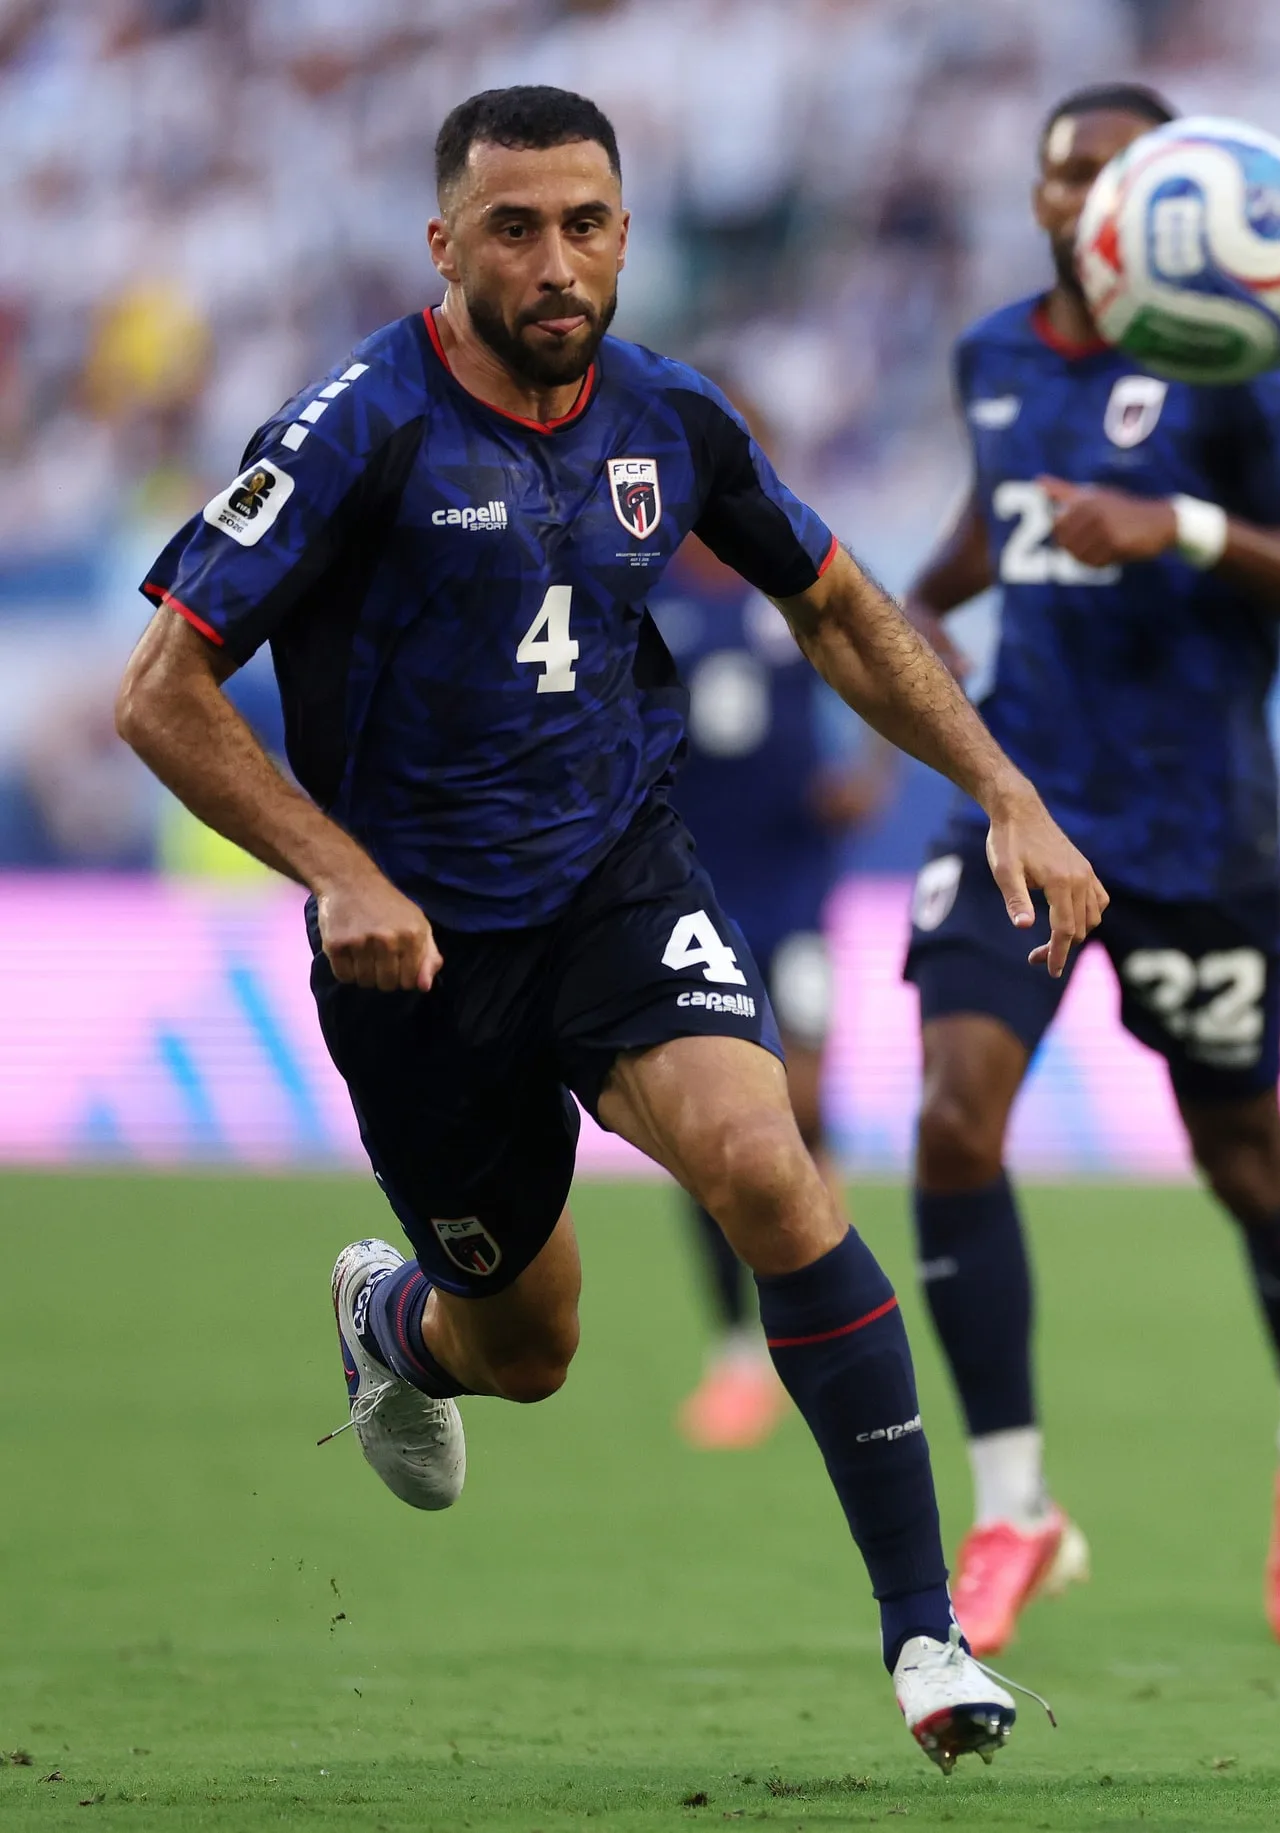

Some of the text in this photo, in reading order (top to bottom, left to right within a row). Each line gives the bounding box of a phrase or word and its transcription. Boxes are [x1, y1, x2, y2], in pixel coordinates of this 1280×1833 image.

[613, 463, 652, 476] FCF
[236, 502, 251, 516] FIFA
[431, 500, 508, 529] capelli
[218, 514, 244, 533] 2026
[469, 522, 508, 531] SPORT
[516, 585, 580, 694] 4
[661, 909, 748, 986] 4
[677, 991, 755, 1014] capelli
[714, 1005, 756, 1018] SPORT
[436, 1221, 475, 1233] FCF
[856, 1413, 921, 1441] capel
